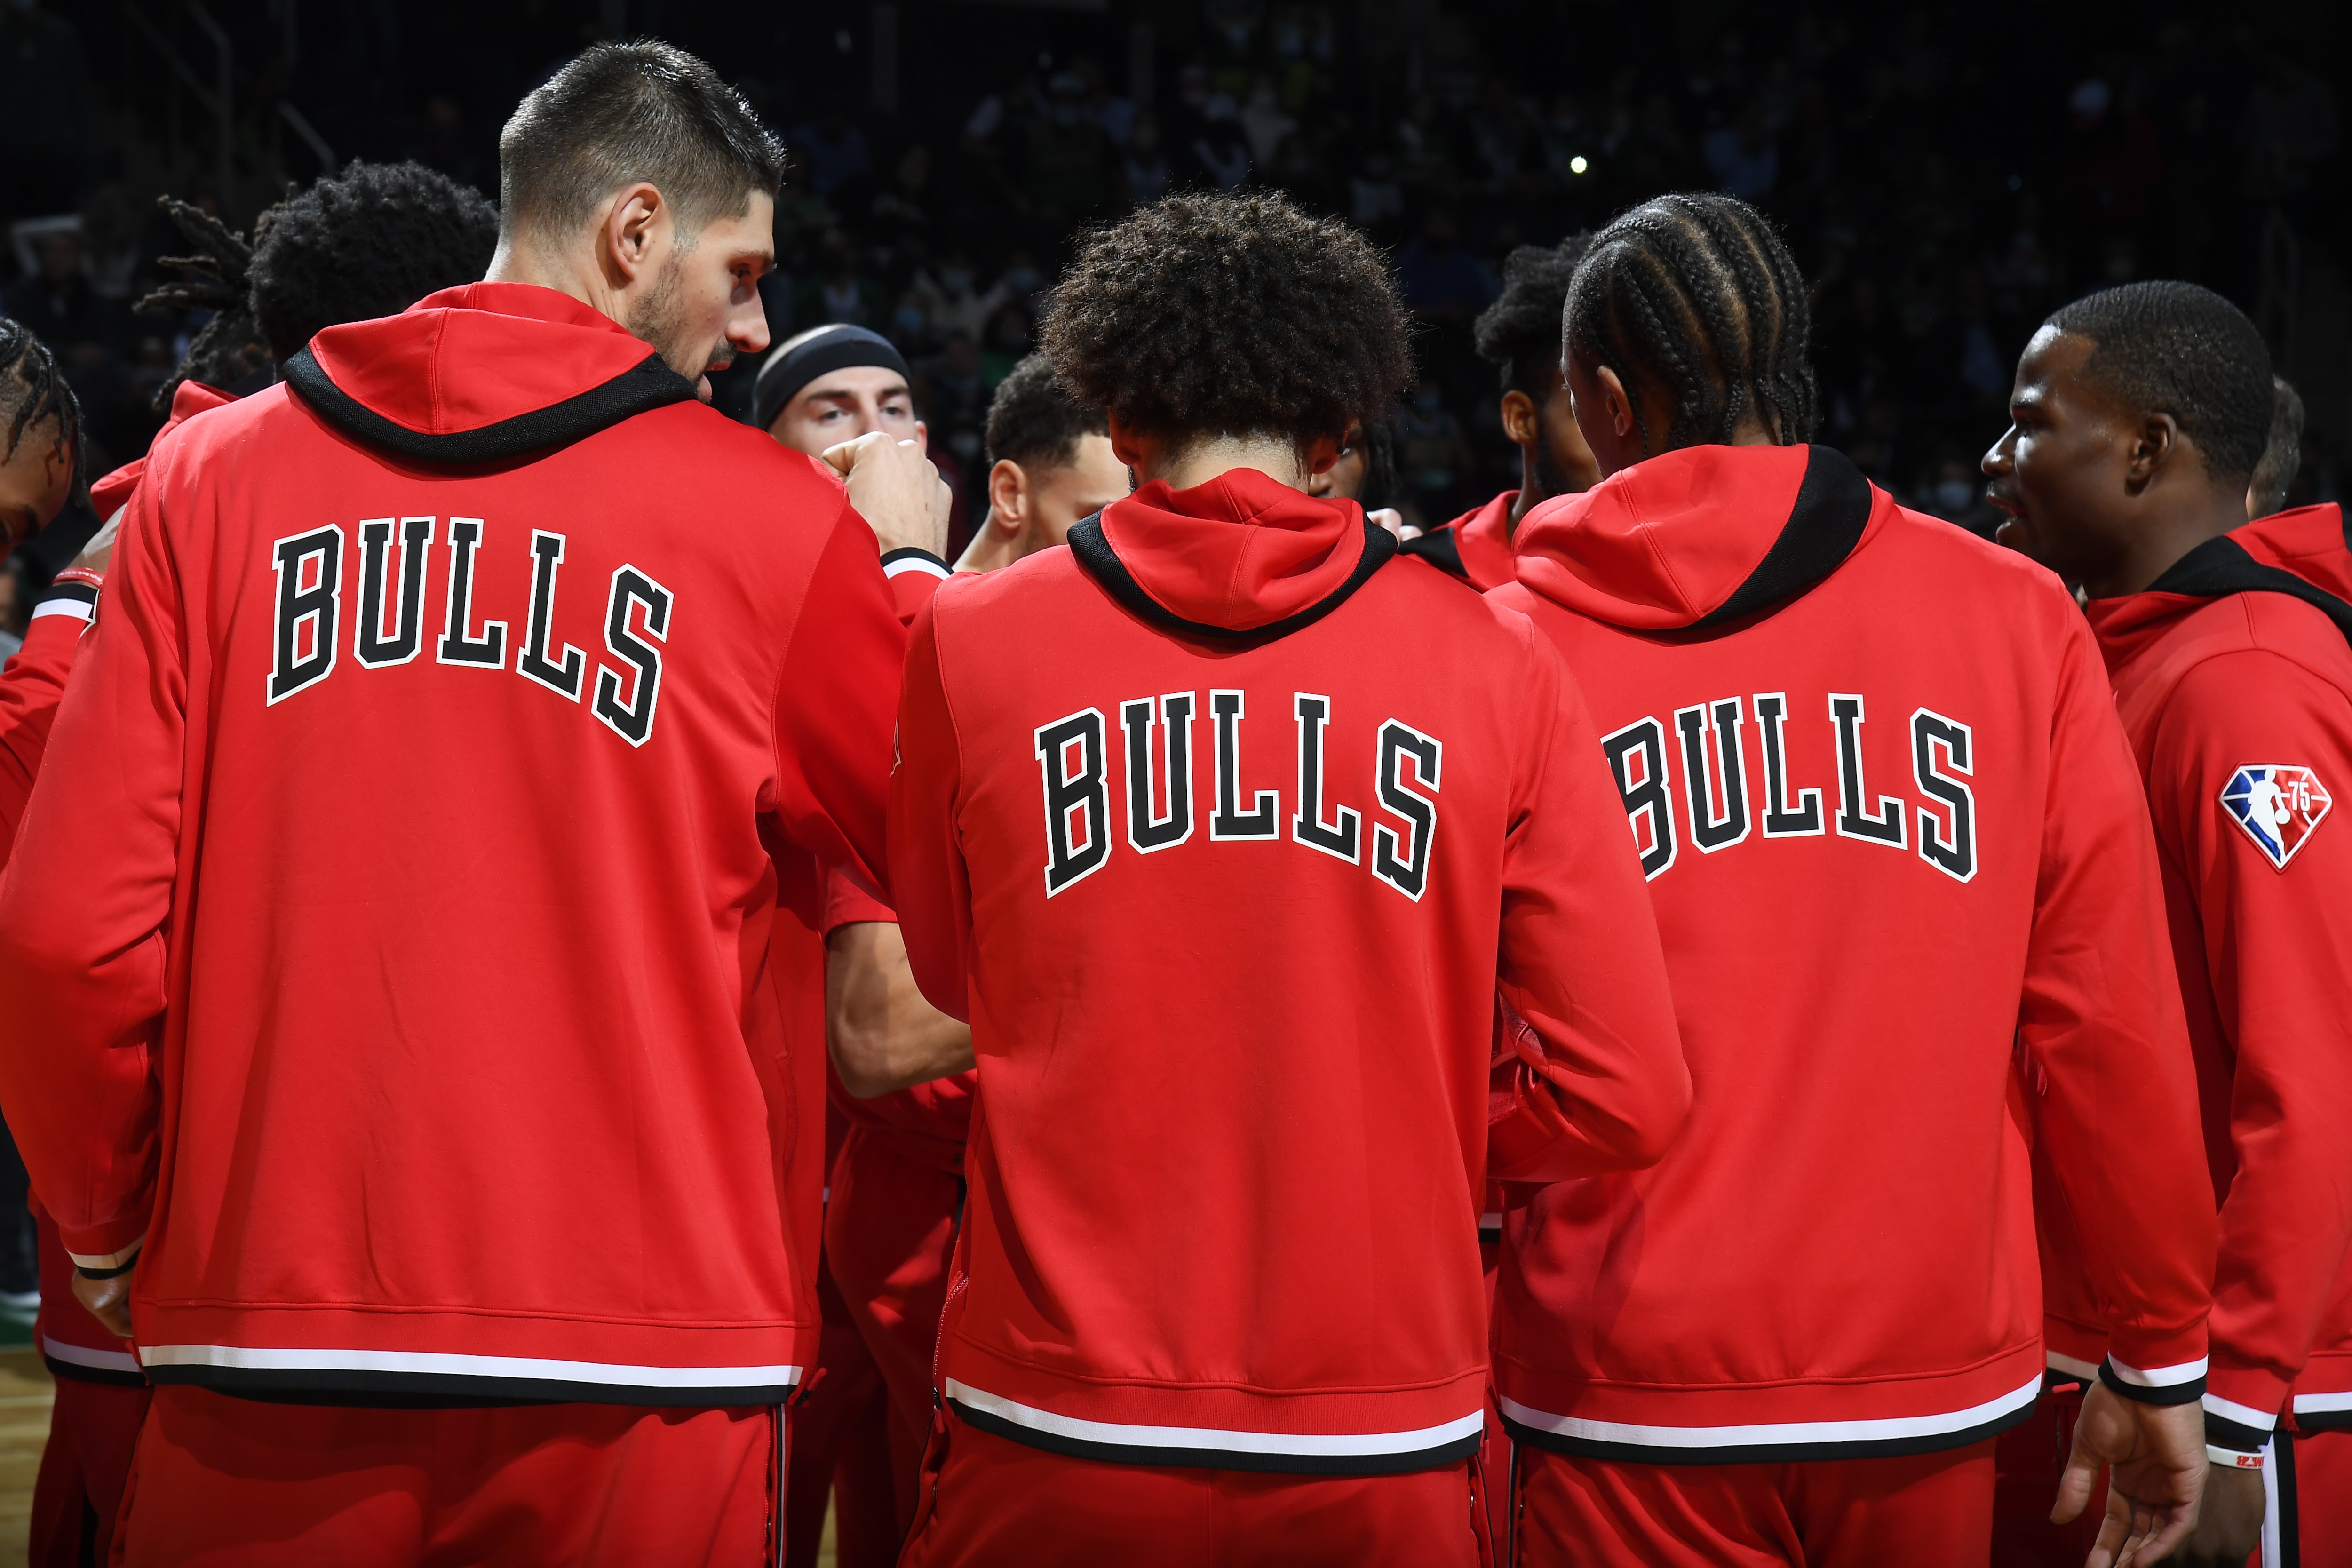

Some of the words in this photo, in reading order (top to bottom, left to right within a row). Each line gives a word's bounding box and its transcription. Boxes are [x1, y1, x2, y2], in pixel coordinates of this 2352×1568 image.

[267, 516, 674, 748] BULLS
[1034, 689, 1442, 902] BULLS
[1600, 692, 1977, 883] BULLS
[2288, 781, 2311, 812] 75
